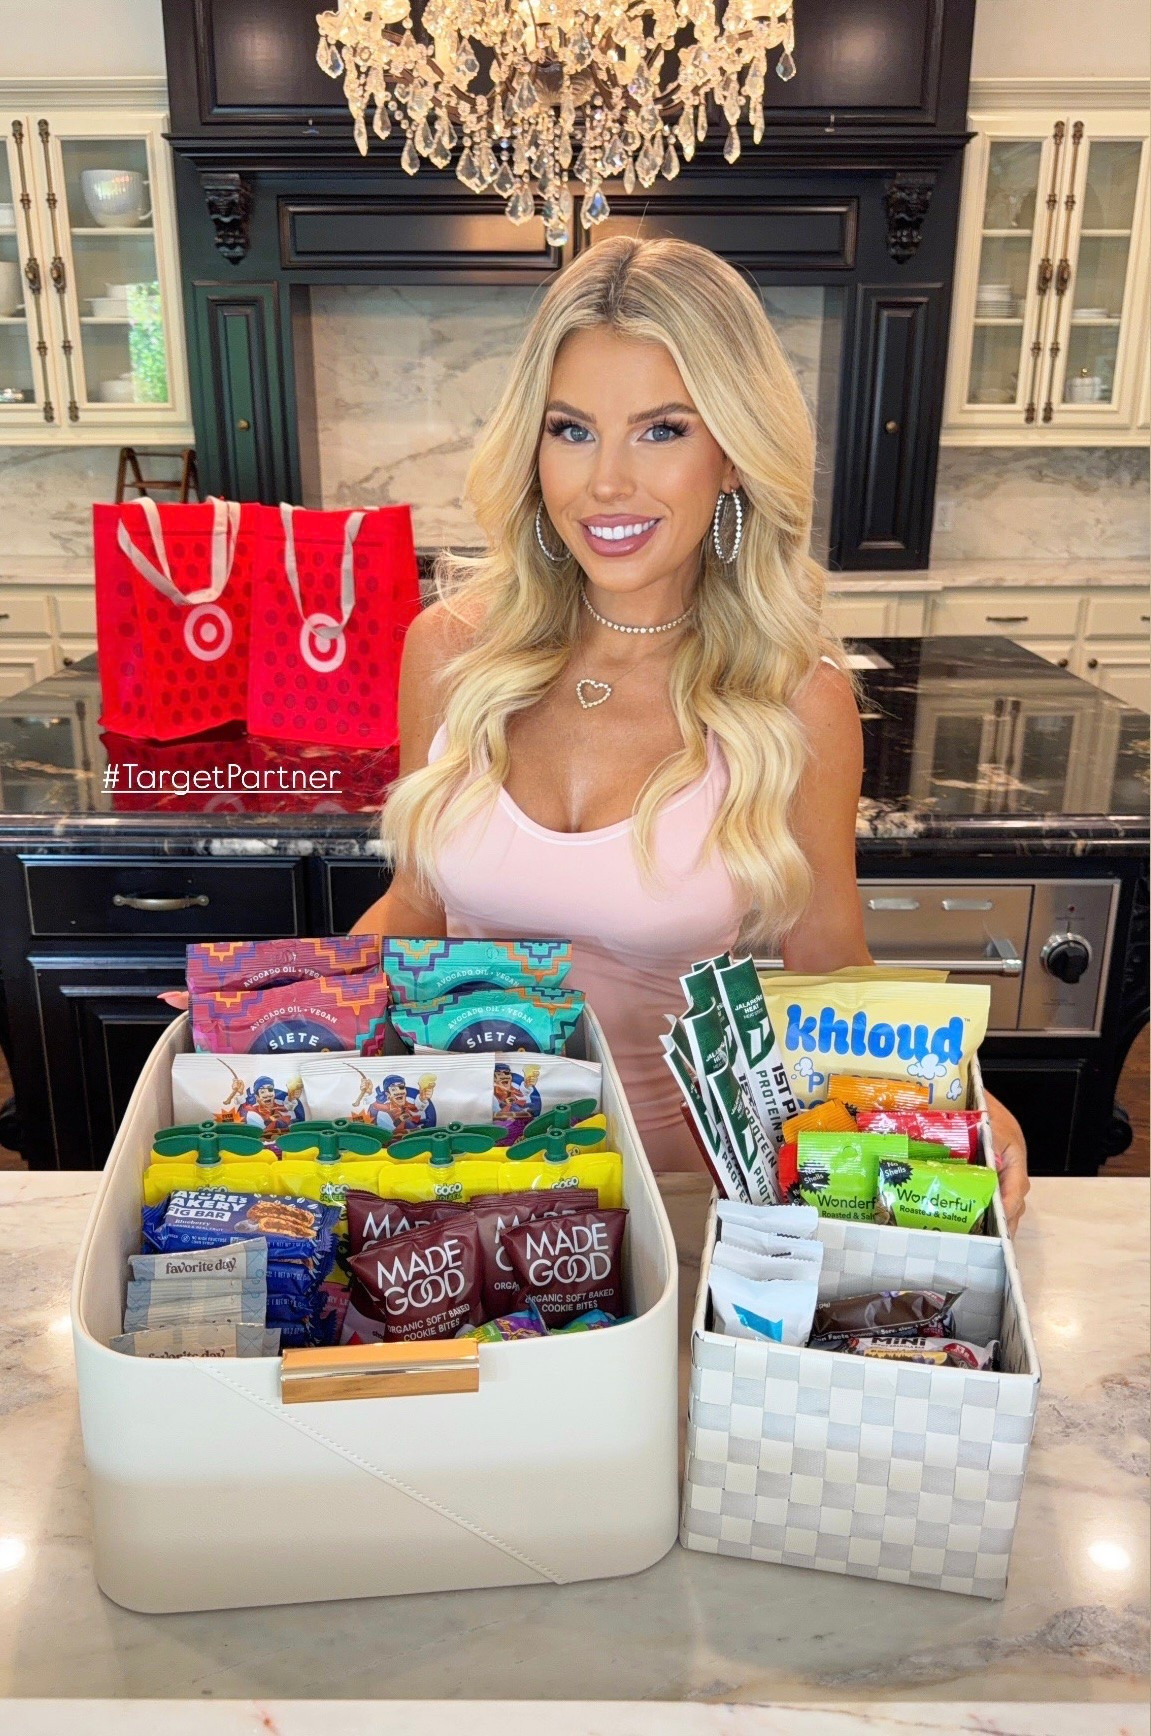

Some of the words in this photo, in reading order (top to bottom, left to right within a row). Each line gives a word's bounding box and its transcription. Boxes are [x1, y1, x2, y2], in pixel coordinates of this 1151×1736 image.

[243, 967, 281, 988] AVOCADO
[282, 966, 297, 974] OIL
[435, 969, 474, 988] AVOCADO
[475, 968, 489, 976] OIL
[496, 972, 520, 988] VEGAN
[250, 1008, 286, 1032] AVOCADO
[310, 1008, 338, 1024] VEGAN
[448, 1007, 484, 1030] AVOCADO
[507, 1007, 534, 1024] VEGAN
[269, 1032, 320, 1050] SIETE
[466, 1031, 517, 1049] SIETE
[785, 1004, 965, 1066] khloud
[756, 1070, 783, 1132] PROTEIN
[803, 1174, 824, 1184] Shells
[884, 1166, 907, 1178] Shells
[320, 1183, 350, 1195] GOGO
[434, 1183, 464, 1195] GOGO
[169, 1197, 246, 1212] AKERY
[817, 1194, 877, 1210] Wonderf
[896, 1188, 973, 1213] Wonderful
[174, 1219, 212, 1227] Blueberry
[194, 1210, 225, 1220] BAR
[821, 1210, 852, 1220] Roasted
[899, 1205, 933, 1217] Roasted
[933, 1210, 940, 1218] &
[942, 1212, 968, 1224] Salted
[526, 1222, 609, 1260] MADE
[165, 1261, 213, 1275] favorite
[215, 1257, 236, 1273] day
[377, 1239, 462, 1289] MADE
[529, 1252, 612, 1287] GOOD
[384, 1268, 465, 1316] GOOD
[566, 1292, 587, 1303] SOFT
[588, 1288, 614, 1299] BAKED
[426, 1311, 447, 1327] SOFT
[449, 1303, 470, 1318] BAKED
[542, 1303, 573, 1313] COOKIE
[576, 1300, 598, 1311] BITES
[403, 1329, 436, 1342] COOKIE
[439, 1317, 460, 1333] BITES
